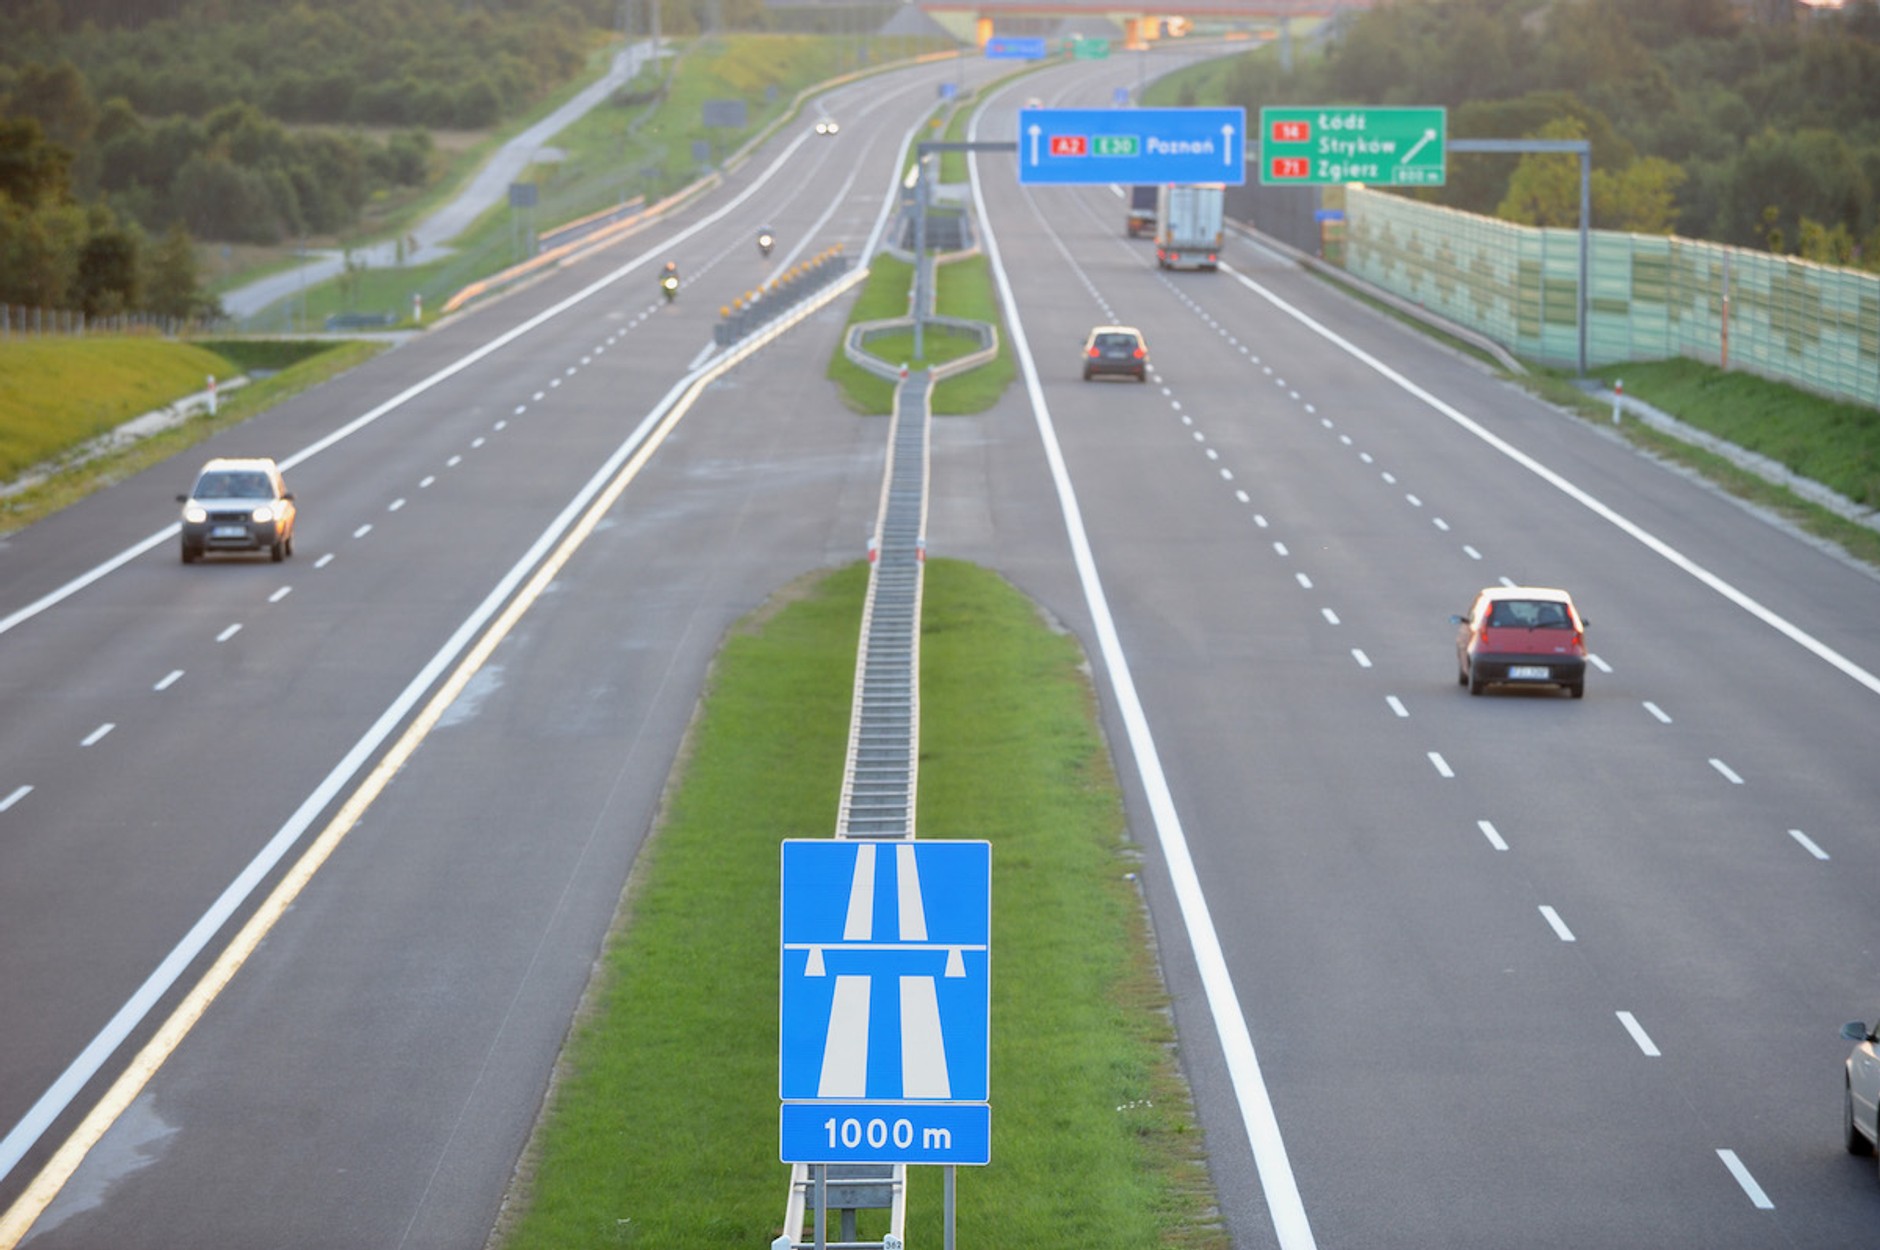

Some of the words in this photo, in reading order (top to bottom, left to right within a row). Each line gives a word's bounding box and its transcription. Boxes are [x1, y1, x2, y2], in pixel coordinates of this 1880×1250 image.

[1318, 113, 1366, 130] Łódź
[1283, 125, 1299, 139] 14
[1057, 138, 1080, 155] A2
[1147, 136, 1214, 155] Poznań
[1318, 136, 1396, 157] Stryków
[1283, 160, 1299, 175] 71
[1318, 160, 1379, 182] Zgierz
[824, 1117, 914, 1149] 1000
[922, 1127, 952, 1150] m
